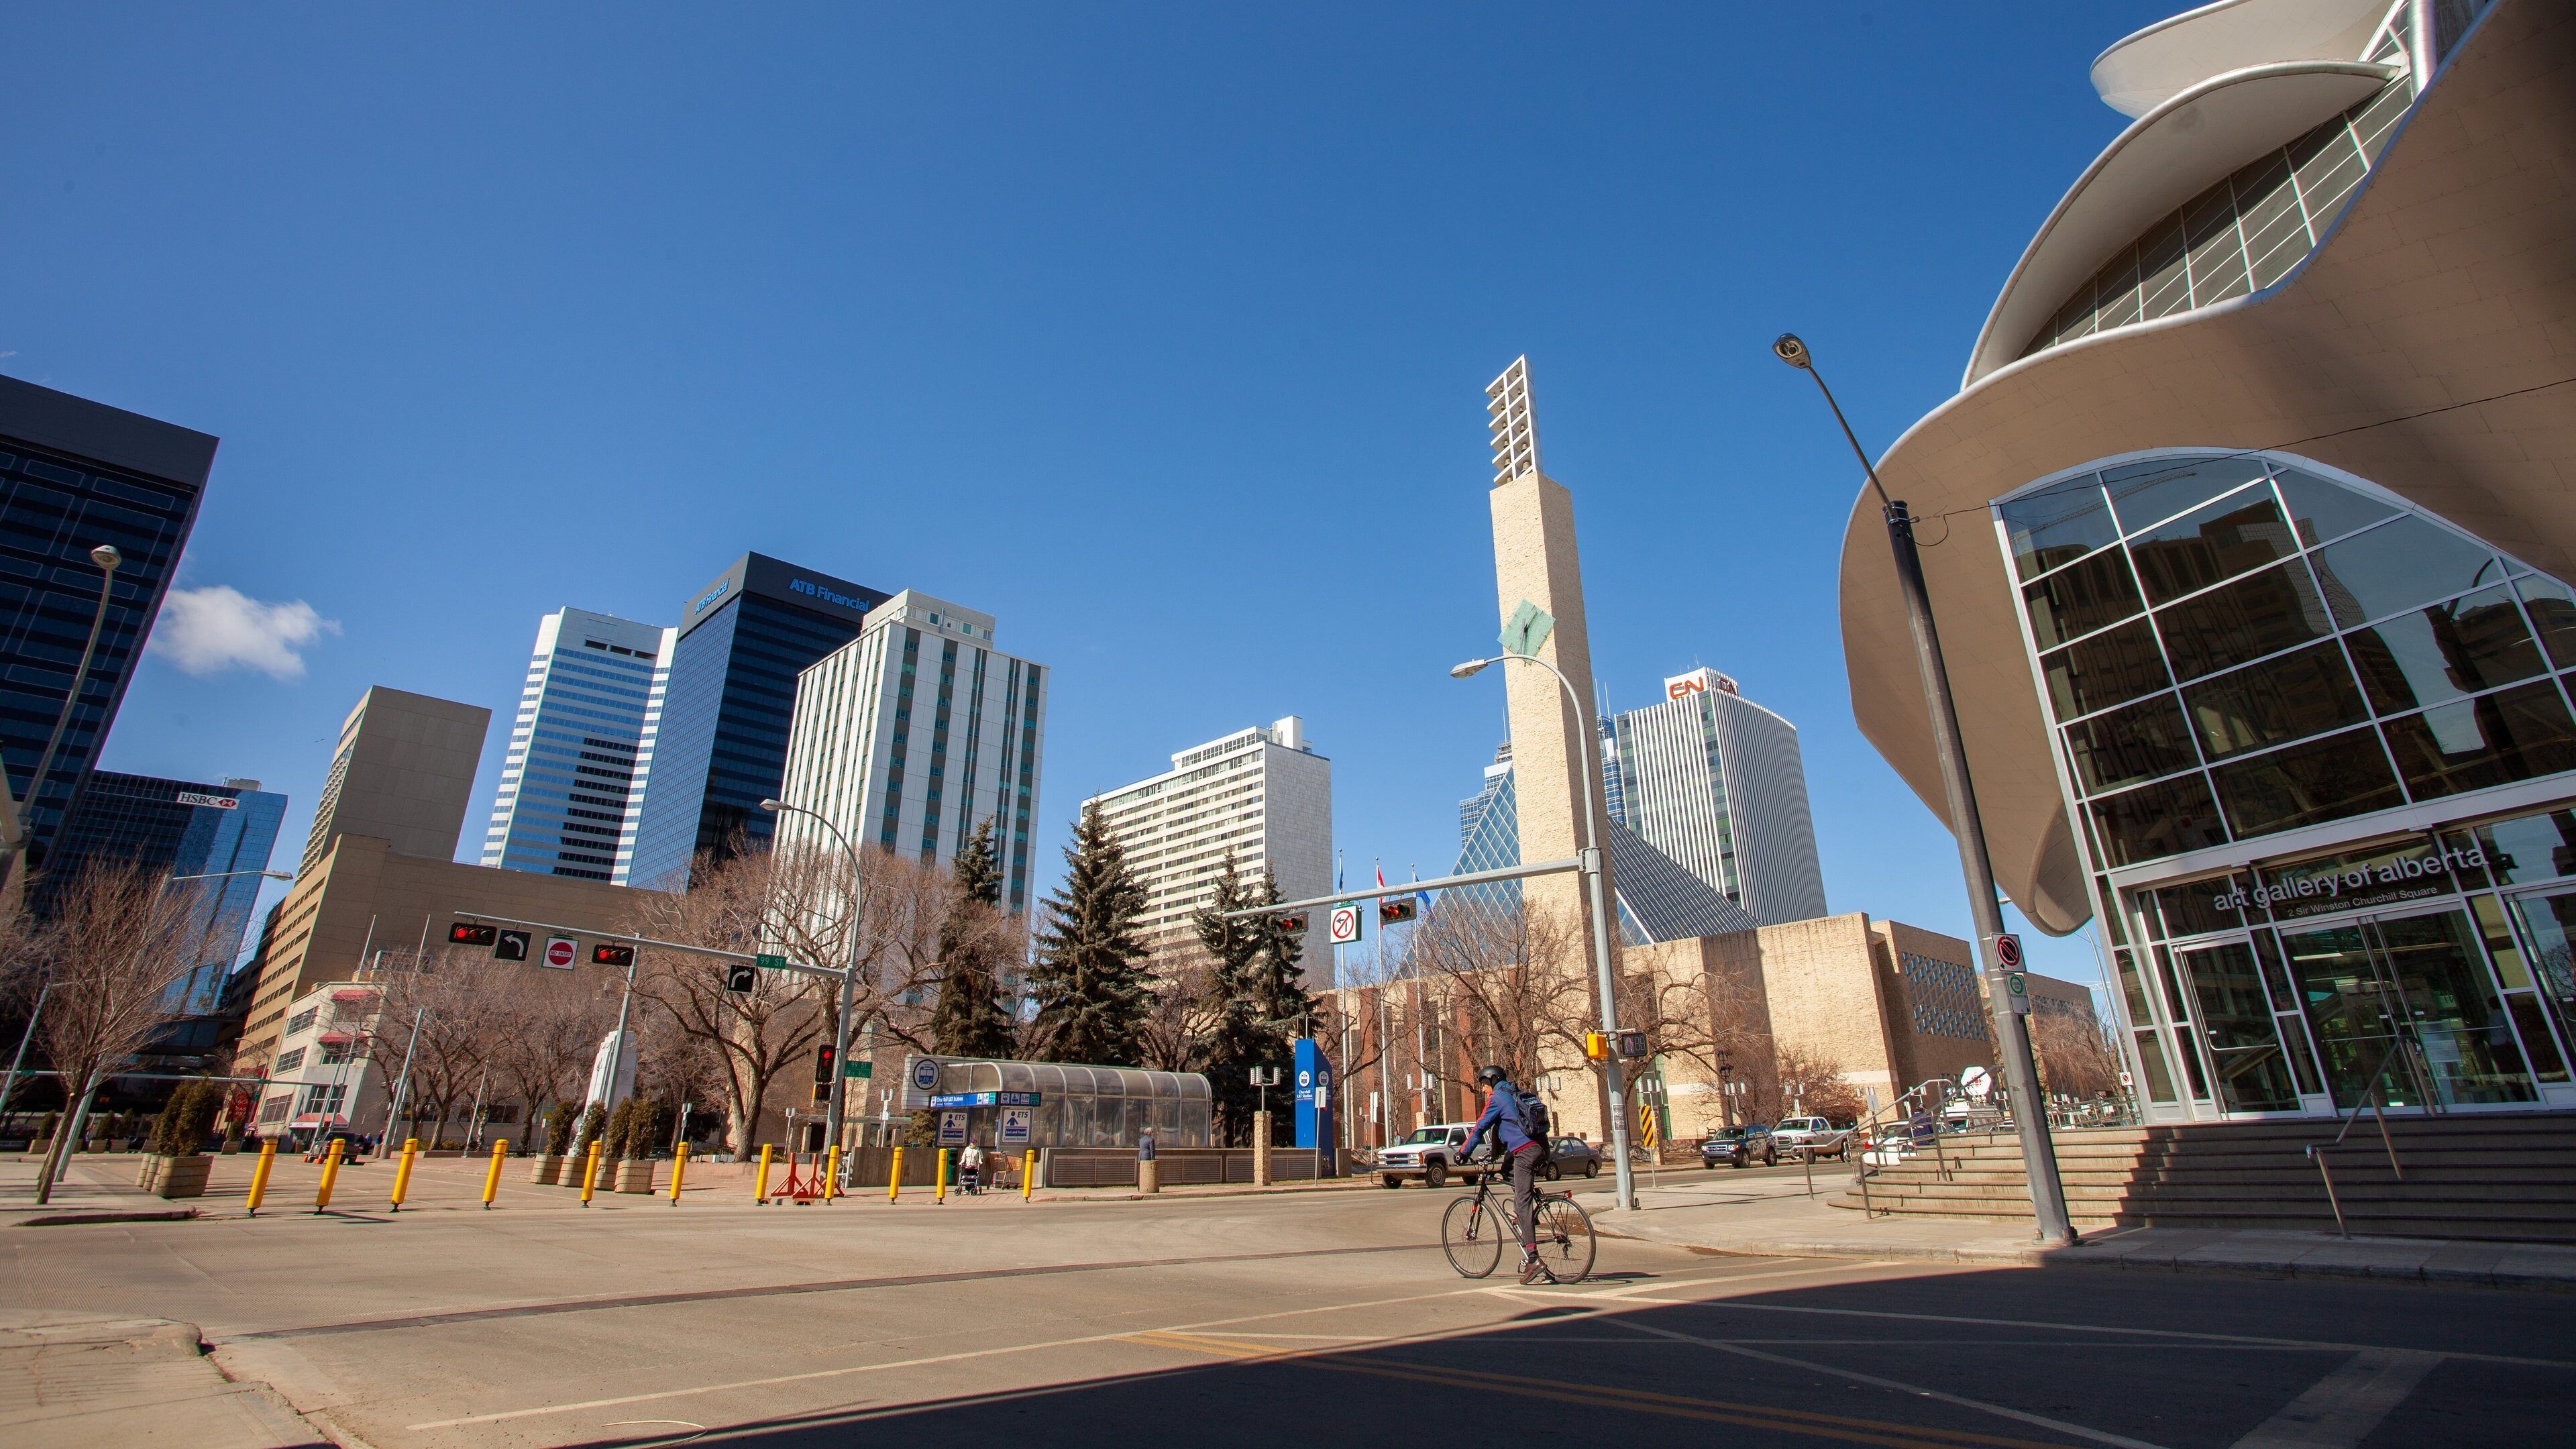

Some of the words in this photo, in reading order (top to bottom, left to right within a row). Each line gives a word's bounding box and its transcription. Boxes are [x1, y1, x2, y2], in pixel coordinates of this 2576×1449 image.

[789, 578, 815, 596] ATB
[816, 586, 869, 612] Financial
[1669, 676, 1704, 700] CN
[180, 793, 217, 805] HSBC
[2214, 886, 2250, 911] art
[2253, 873, 2340, 909] gallery
[2345, 863, 2372, 888] of
[2378, 847, 2489, 882] alberta
[2288, 909, 2295, 917] 2
[2296, 906, 2309, 916] Sir
[2312, 901, 2350, 913] Winston
[2353, 892, 2397, 906] Churchill
[2400, 886, 2438, 900] Square
[760, 957, 769, 965] 99
[774, 958, 784, 966] ST
